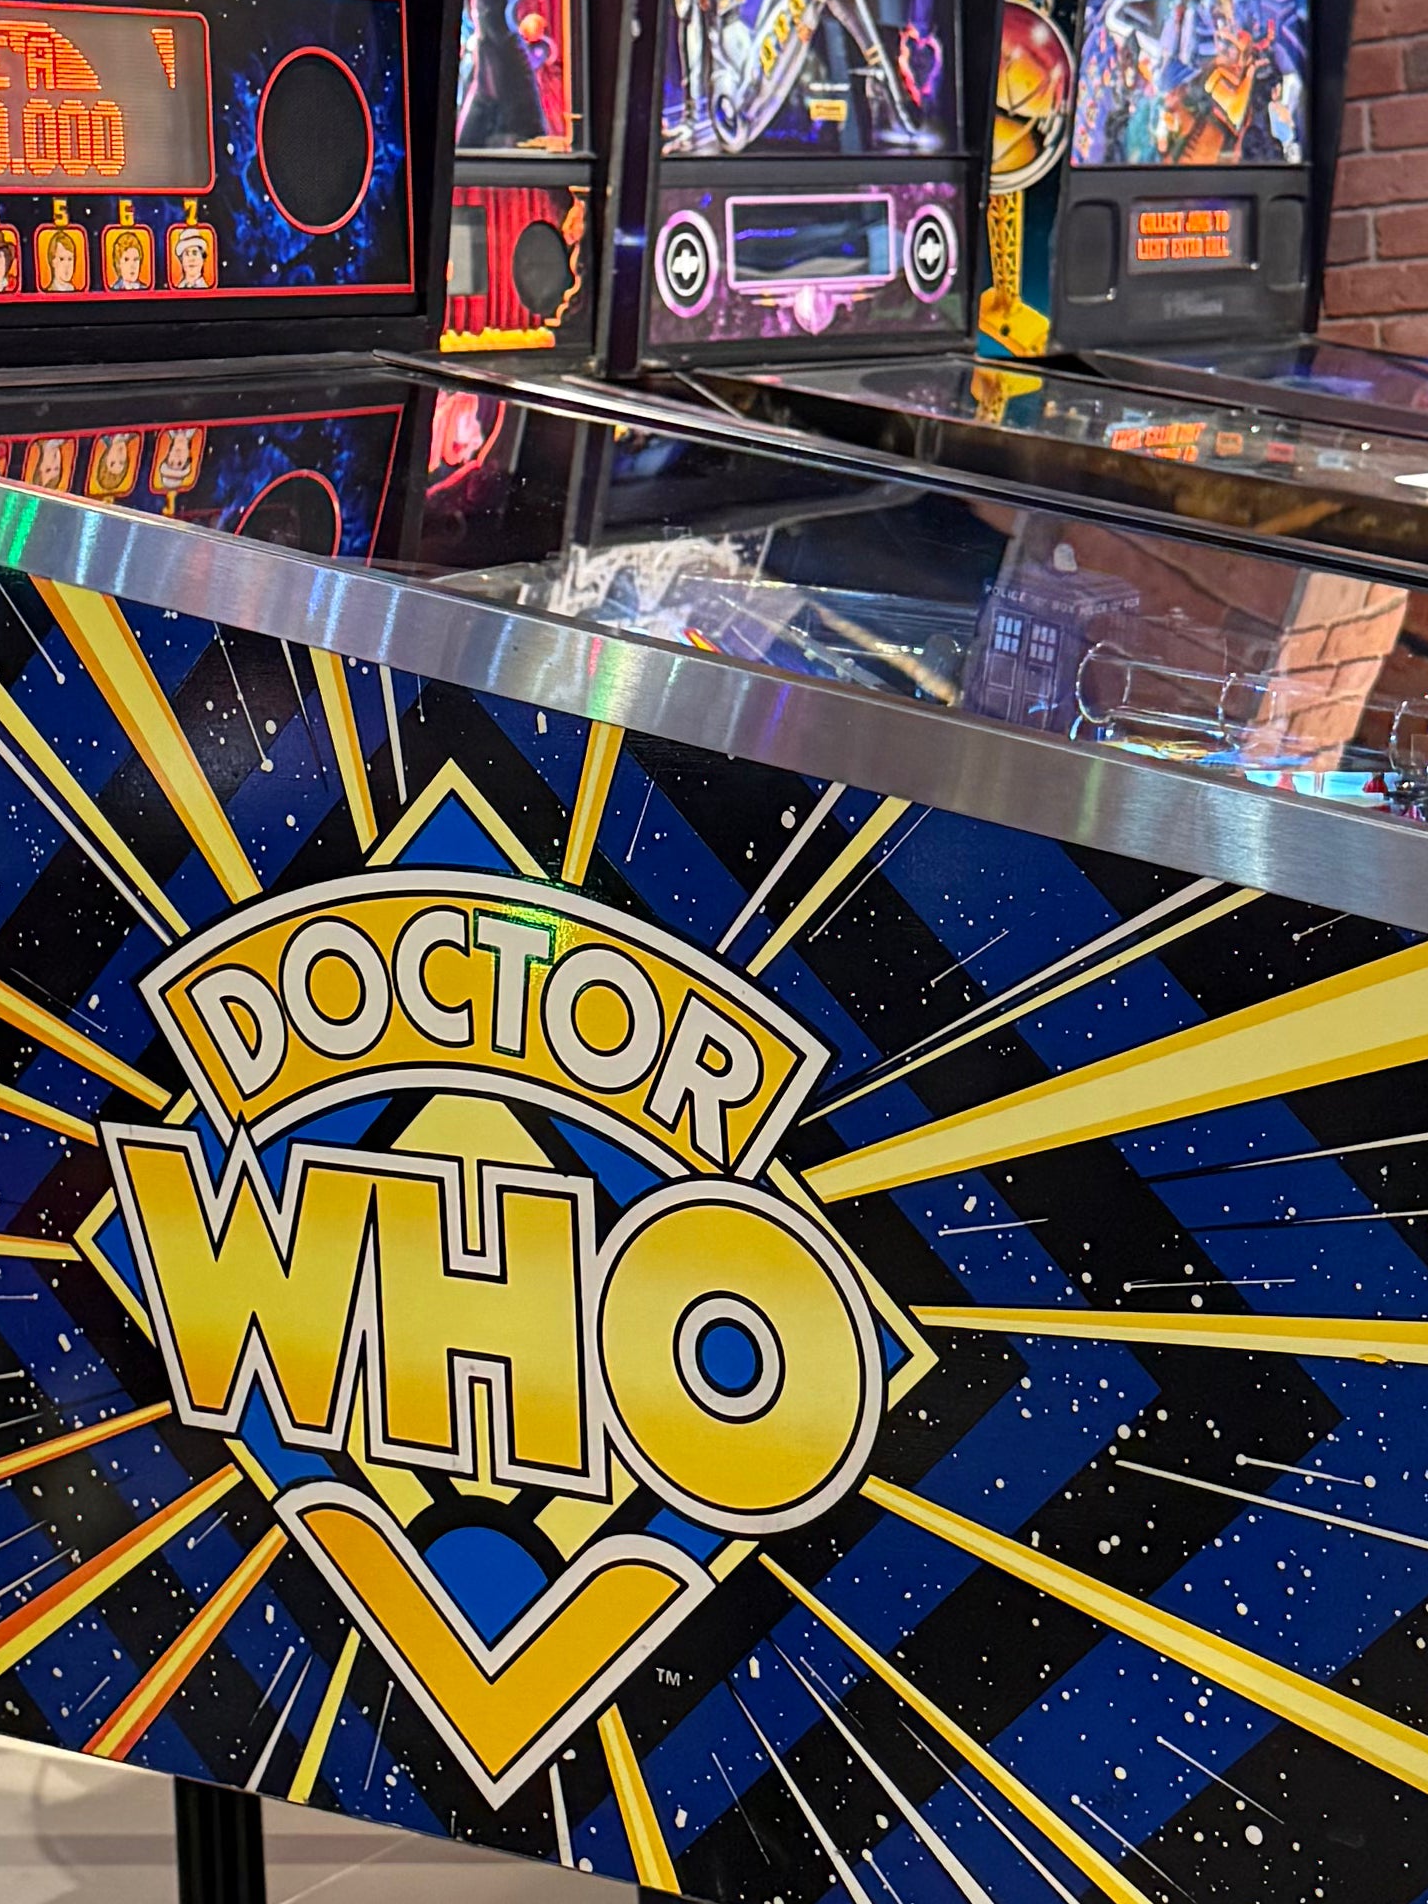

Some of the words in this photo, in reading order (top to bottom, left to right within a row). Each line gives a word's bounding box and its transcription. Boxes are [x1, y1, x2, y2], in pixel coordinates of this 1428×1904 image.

[53, 198, 70, 227] 5
[119, 198, 136, 227] 6
[183, 198, 199, 227] 7
[189, 907, 765, 1173] DOCTOR
[104, 1124, 879, 1533] WHO
[655, 1668, 681, 1688] TM
